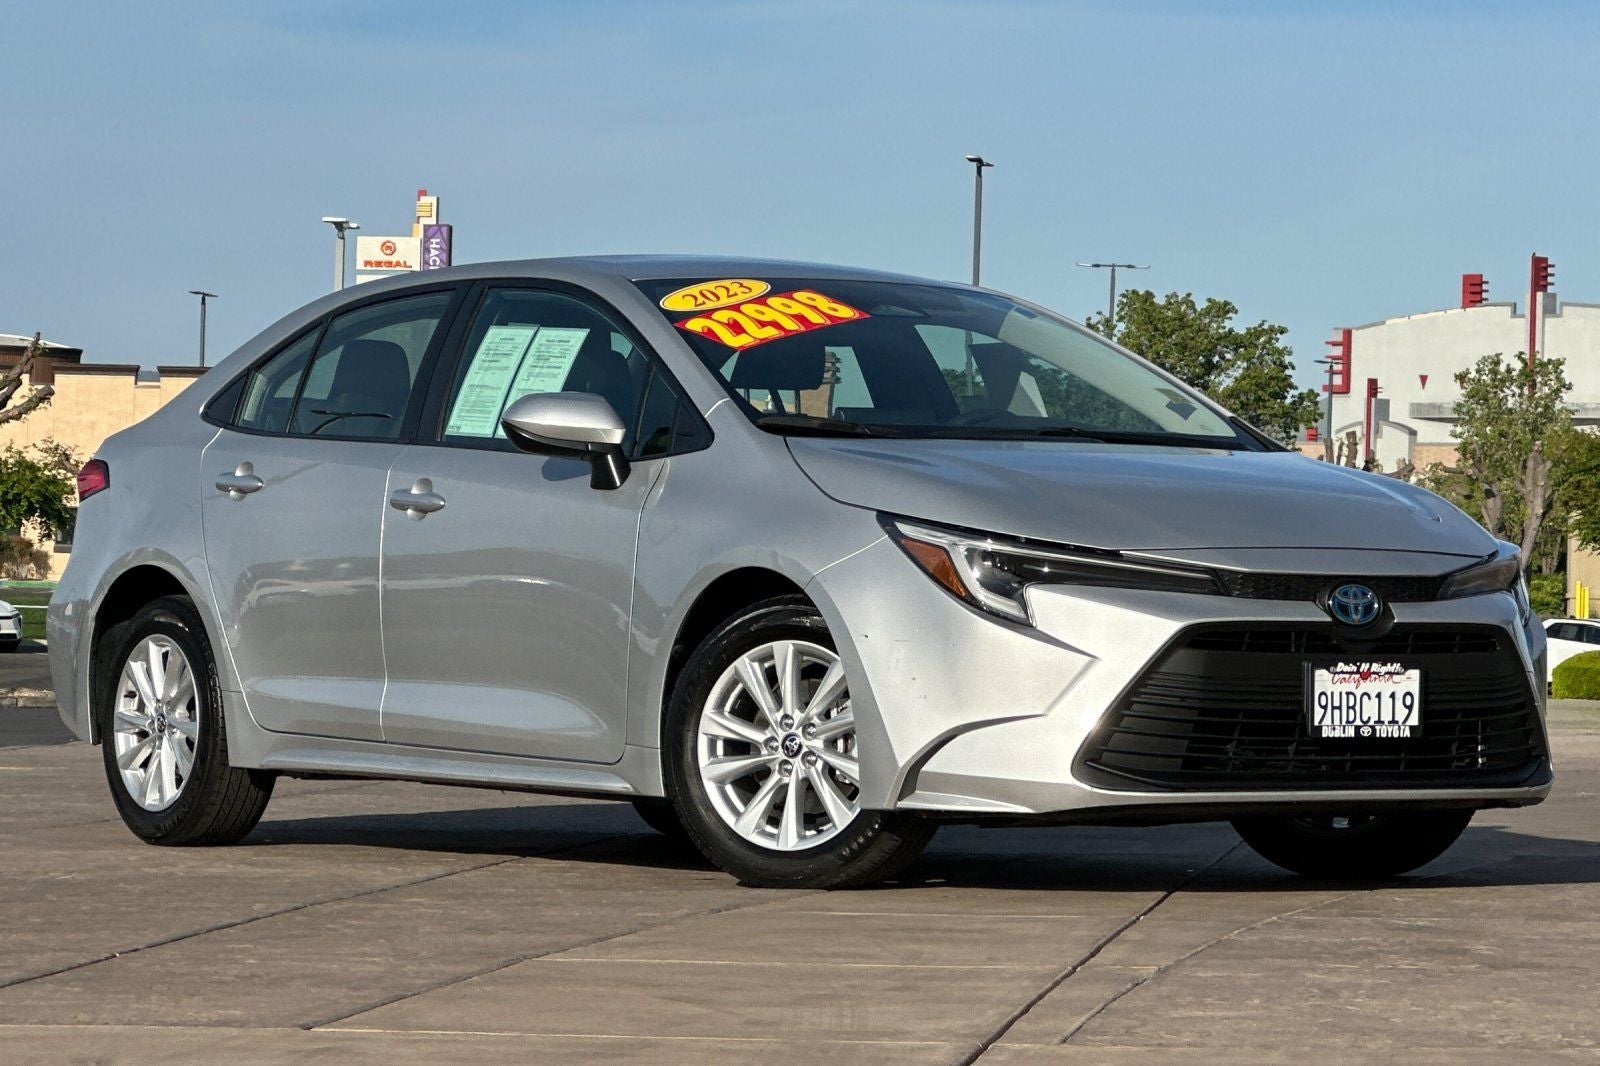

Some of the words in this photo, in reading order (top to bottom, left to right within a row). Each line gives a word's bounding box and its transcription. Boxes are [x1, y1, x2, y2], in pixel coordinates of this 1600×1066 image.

[363, 259, 413, 269] REGAL
[682, 281, 752, 308] 2023
[684, 290, 860, 348] 22998
[1336, 662, 1360, 672] Doin'
[1360, 662, 1370, 672] It
[1370, 662, 1399, 675] Right!
[1331, 673, 1401, 689] Califrnia
[1317, 690, 1415, 725] 9HBC119
[1321, 725, 1355, 738] DUBLIN
[1375, 725, 1411, 738] TOYOTA
